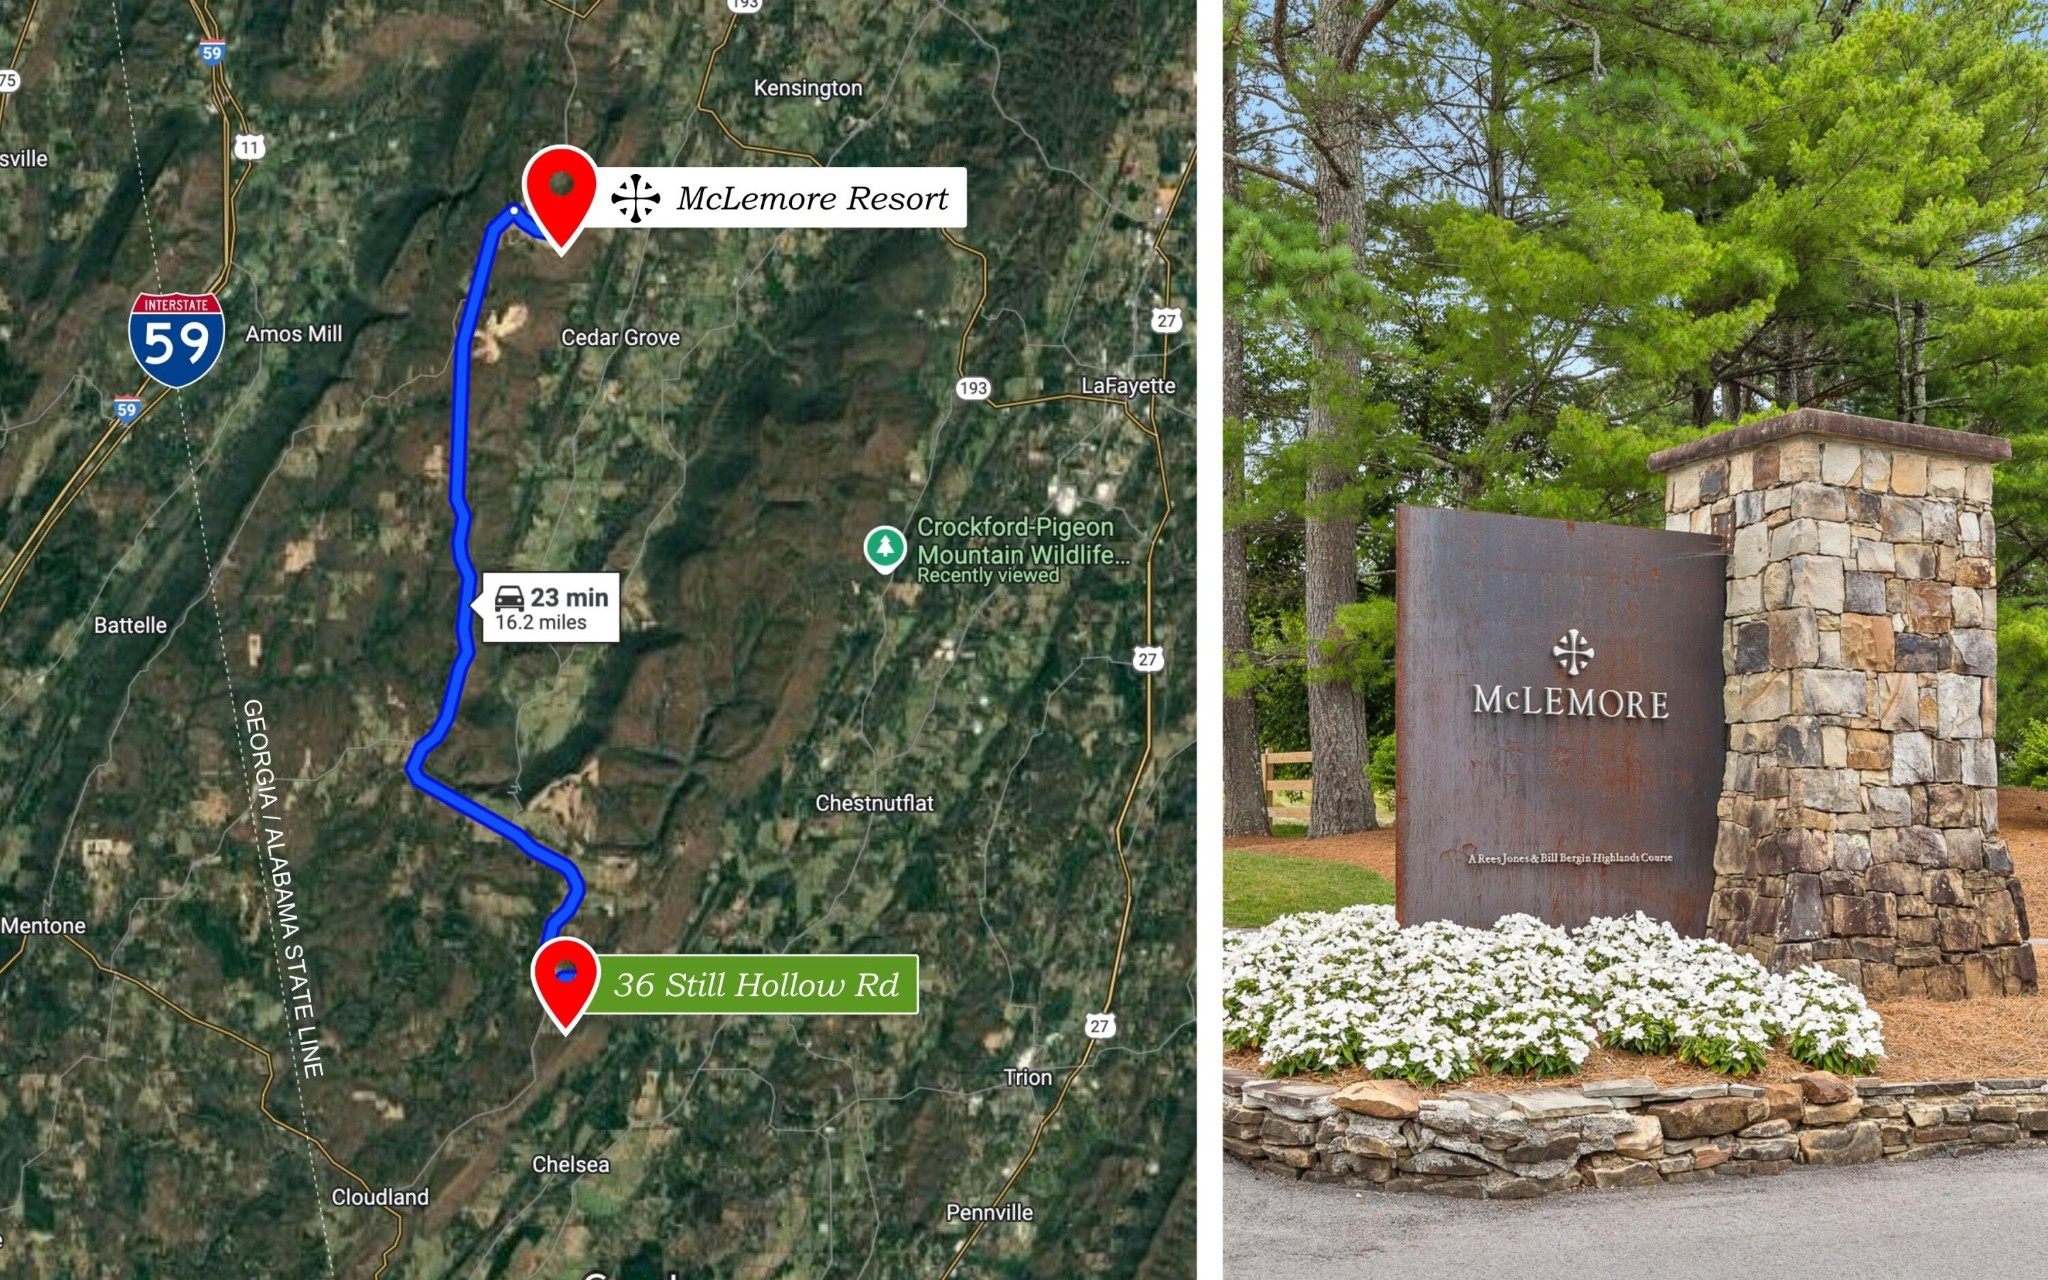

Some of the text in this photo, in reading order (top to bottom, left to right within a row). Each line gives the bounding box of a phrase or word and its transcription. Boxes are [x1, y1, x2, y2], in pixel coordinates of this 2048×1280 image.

[1472, 684, 1670, 719] McLEMORE
[1468, 853, 1673, 865] A Rees Jones & Bill Bergin Highlands Course
